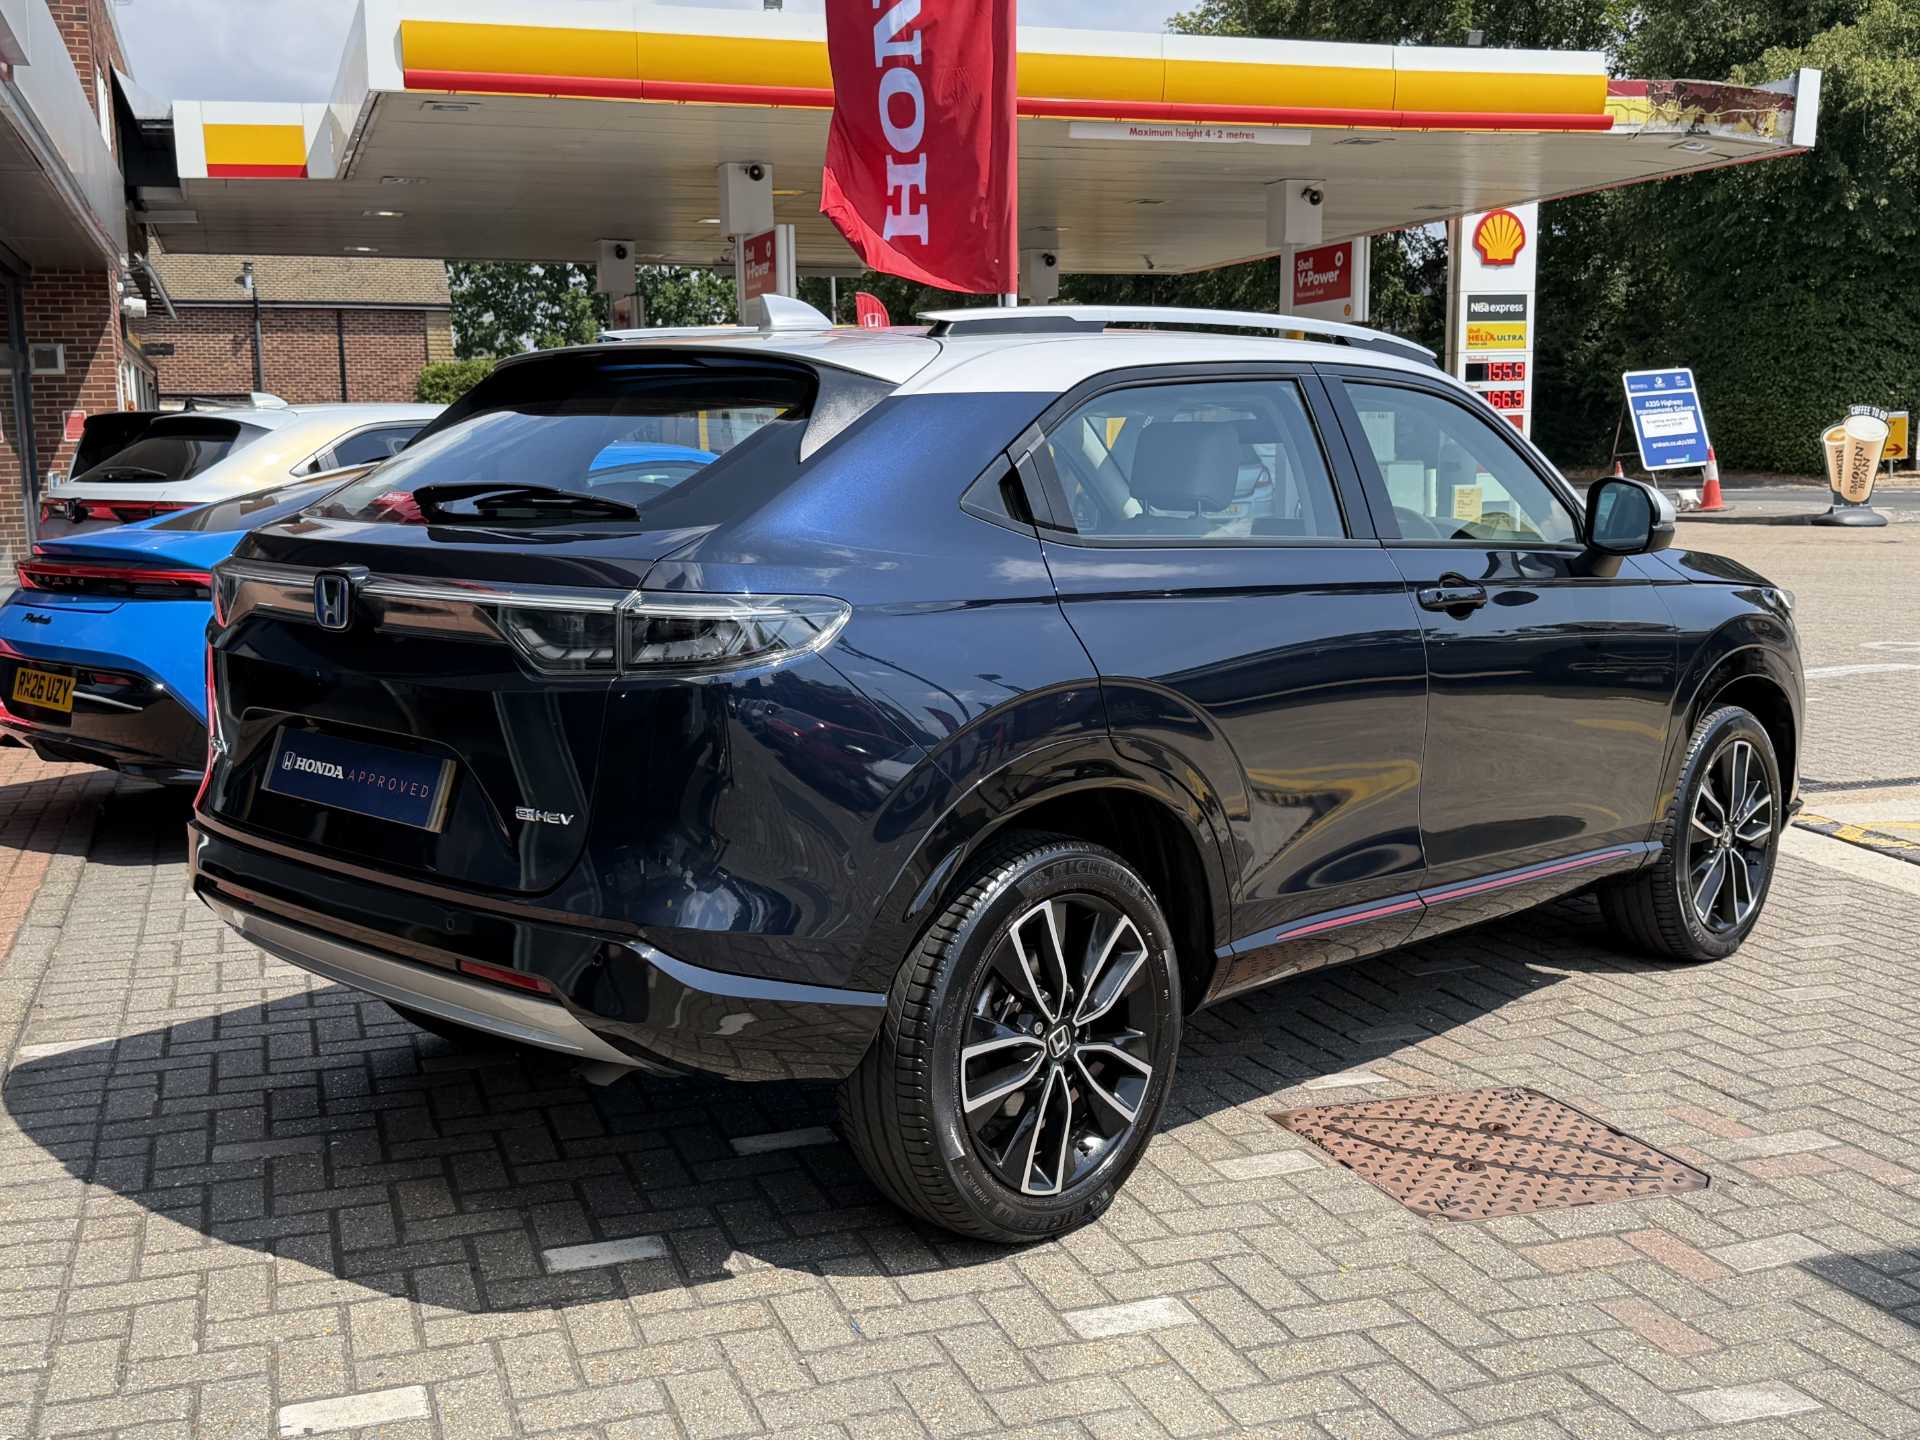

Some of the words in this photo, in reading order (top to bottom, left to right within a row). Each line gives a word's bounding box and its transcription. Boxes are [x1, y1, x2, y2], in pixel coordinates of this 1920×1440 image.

[1129, 127, 1173, 138] Maximum
[1175, 128, 1202, 140] height
[1226, 131, 1255, 140] metres
[1297, 257, 1313, 271] Shell
[1297, 270, 1340, 288] V-Power
[1468, 332, 1496, 342] HELIX
[1497, 334, 1524, 342] ULTRA
[1488, 362, 1525, 381] 155.9
[1488, 390, 1524, 409] 166.9
[1851, 405, 1870, 415] COFFEE
[1872, 407, 1880, 417] TO
[1858, 457, 1870, 489] BEAN
[16, 671, 46, 700] RX26
[46, 675, 71, 705] UZY
[294, 757, 344, 779] HONDA
[348, 768, 429, 798] APPROVED
